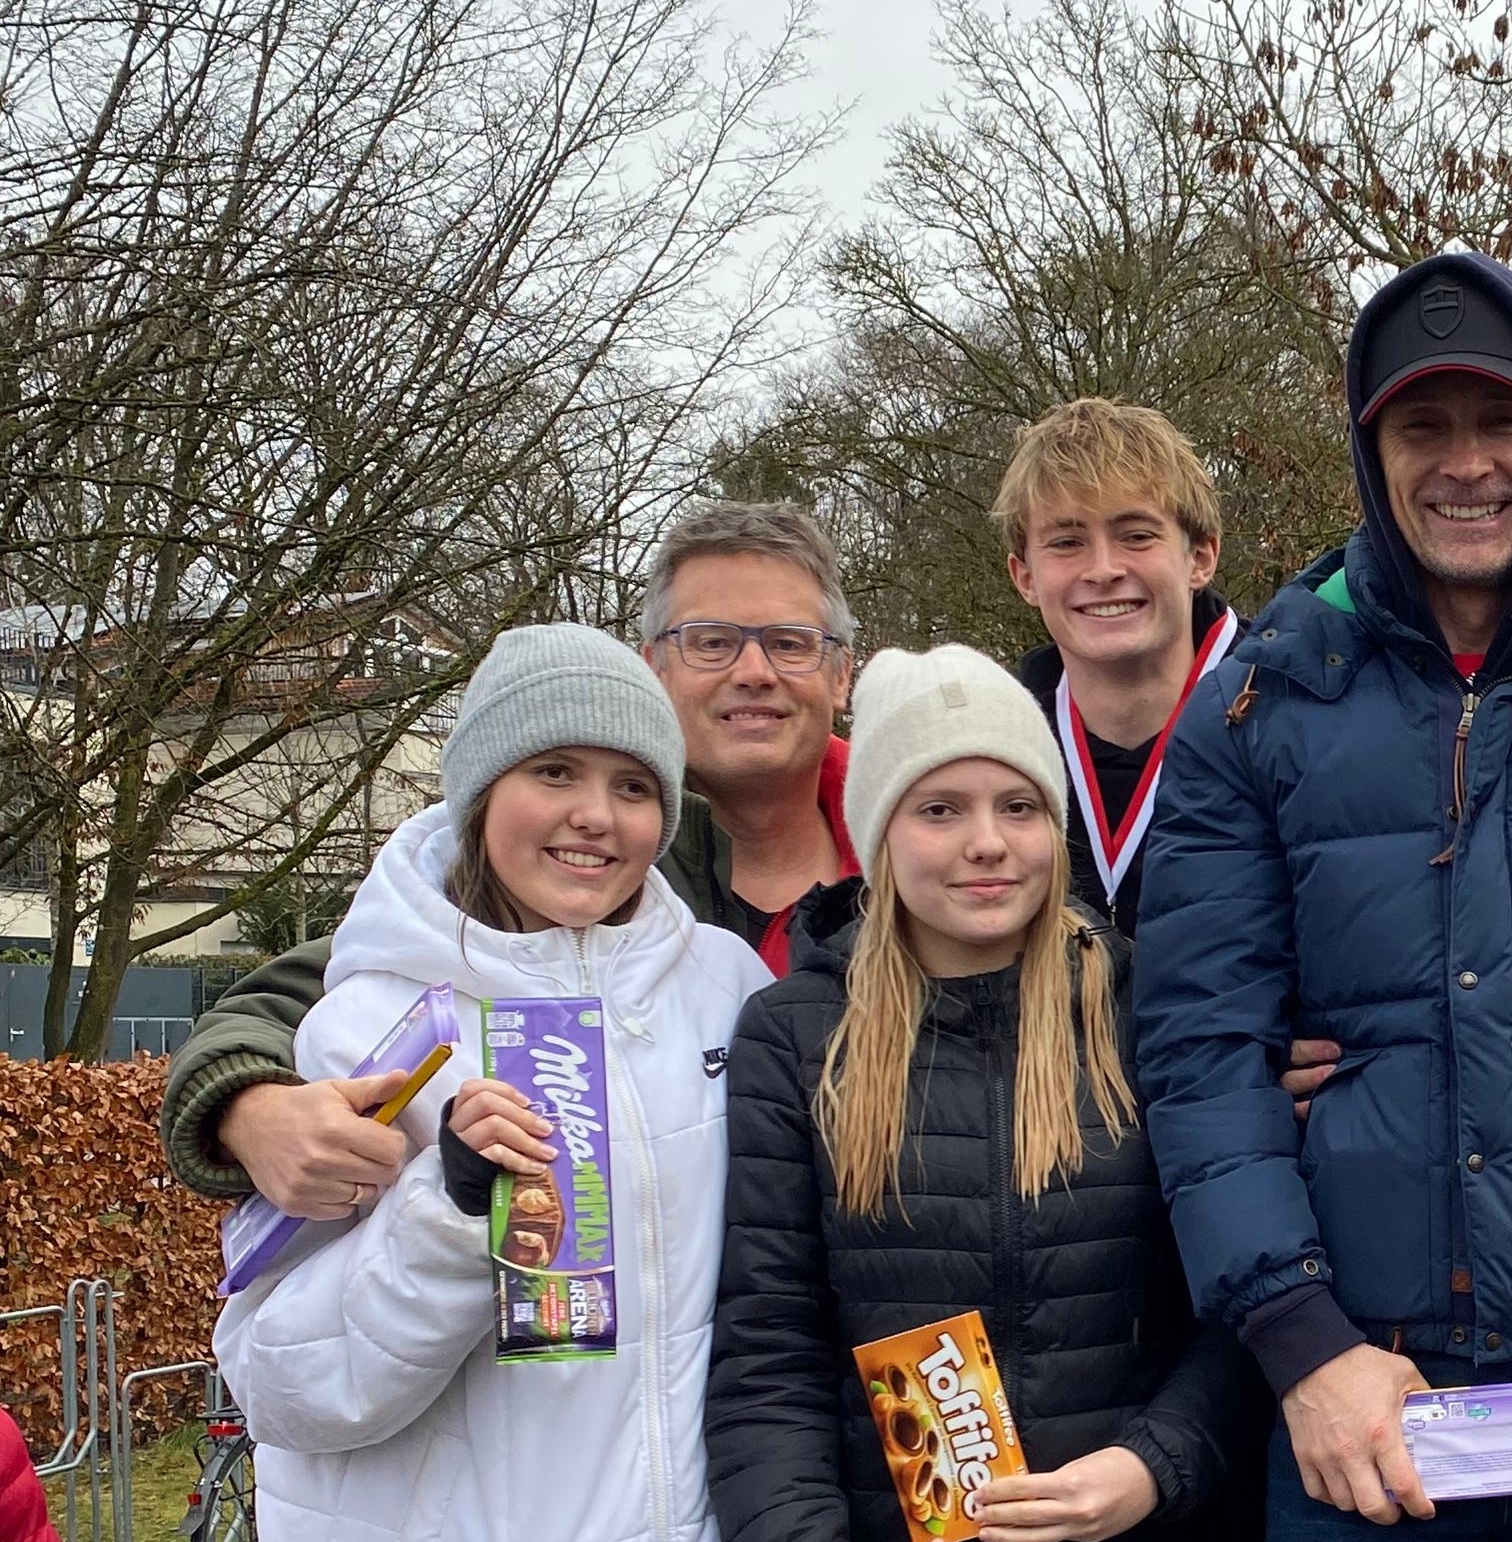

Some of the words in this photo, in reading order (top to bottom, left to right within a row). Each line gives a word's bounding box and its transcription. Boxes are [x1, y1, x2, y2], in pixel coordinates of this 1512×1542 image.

[529, 1034, 604, 1166] Milka
[572, 1157, 610, 1263] MMMAX
[568, 1279, 588, 1339] ARENA
[992, 1386, 1015, 1447] Toffifee
